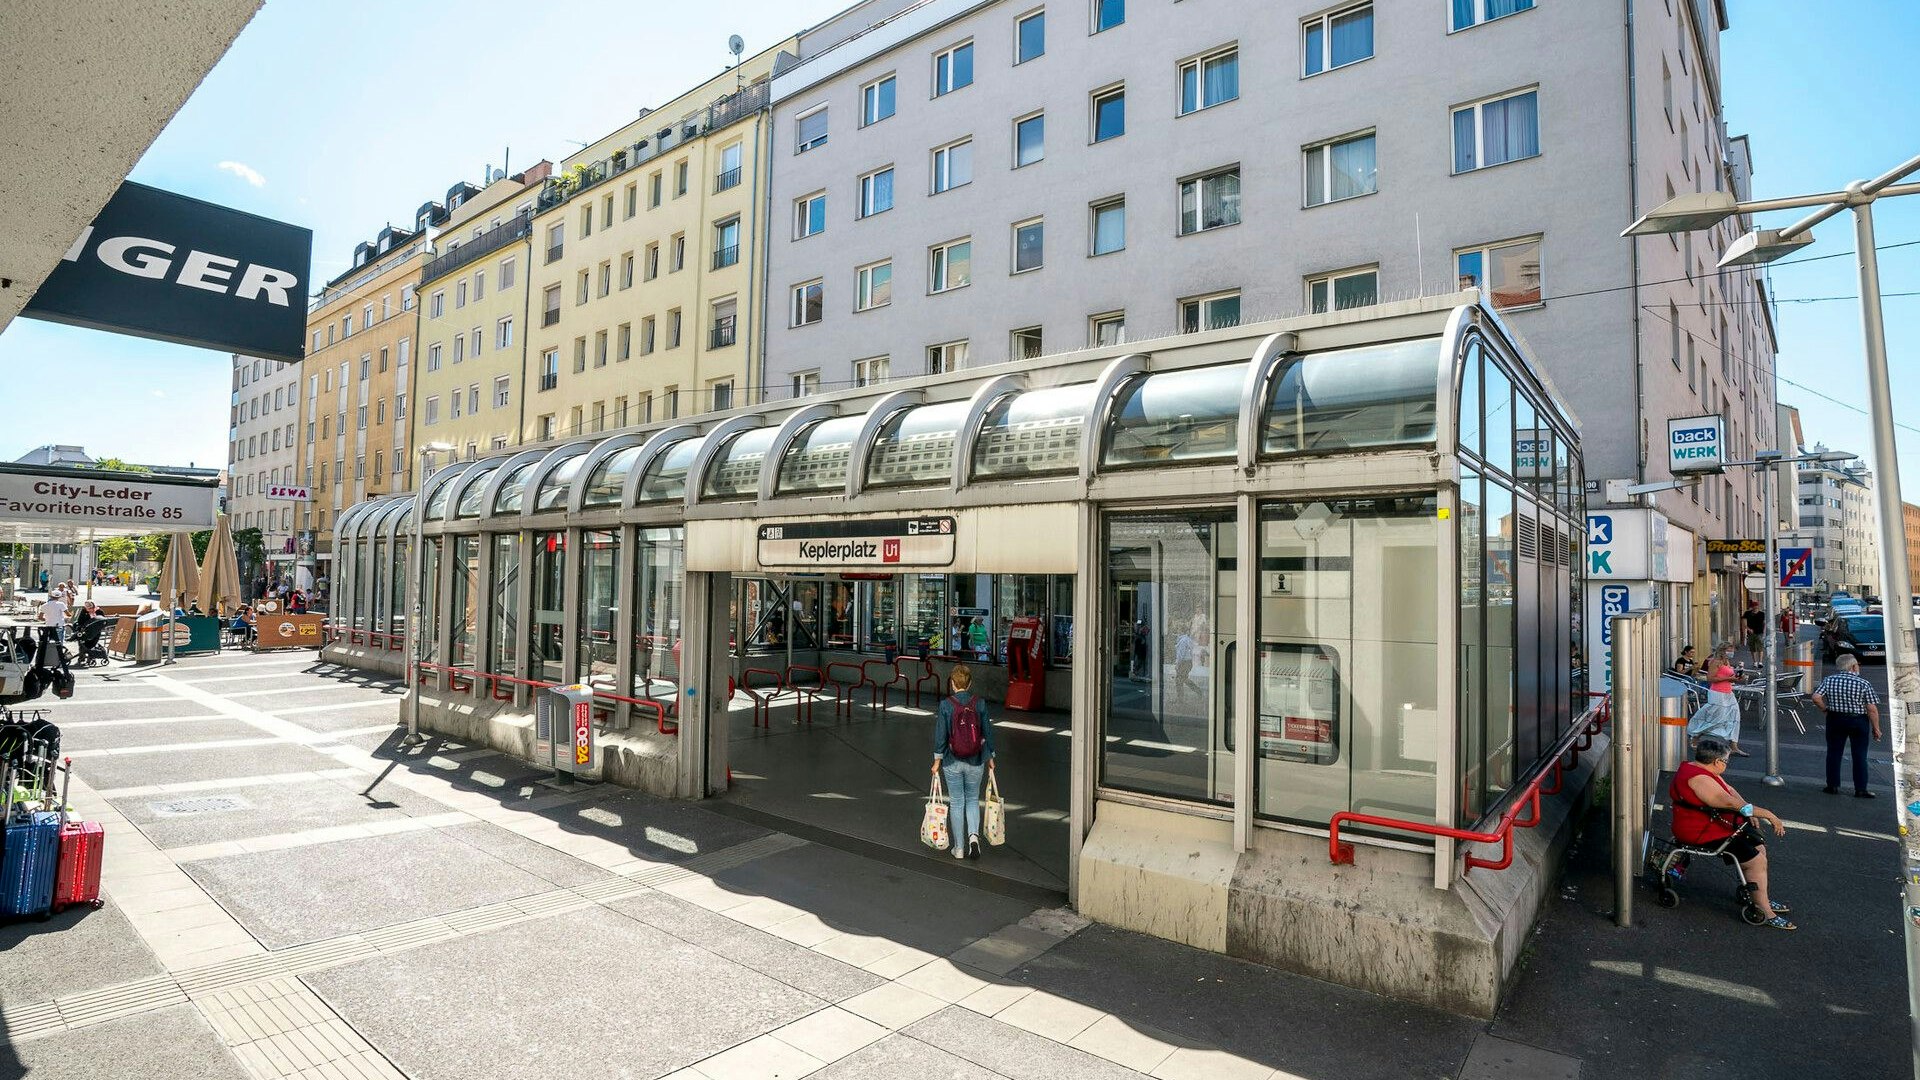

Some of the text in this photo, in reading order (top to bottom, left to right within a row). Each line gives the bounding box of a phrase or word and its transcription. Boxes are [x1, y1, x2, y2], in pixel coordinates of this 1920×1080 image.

[1674, 428, 1714, 442] back
[1673, 445, 1717, 459] WERK
[33, 481, 152, 500] City-Leder
[271, 487, 307, 497] SEWA
[1586, 481, 1597, 489] 00
[162, 506, 183, 519] 85
[799, 541, 898, 561] Keplerplatz U1
